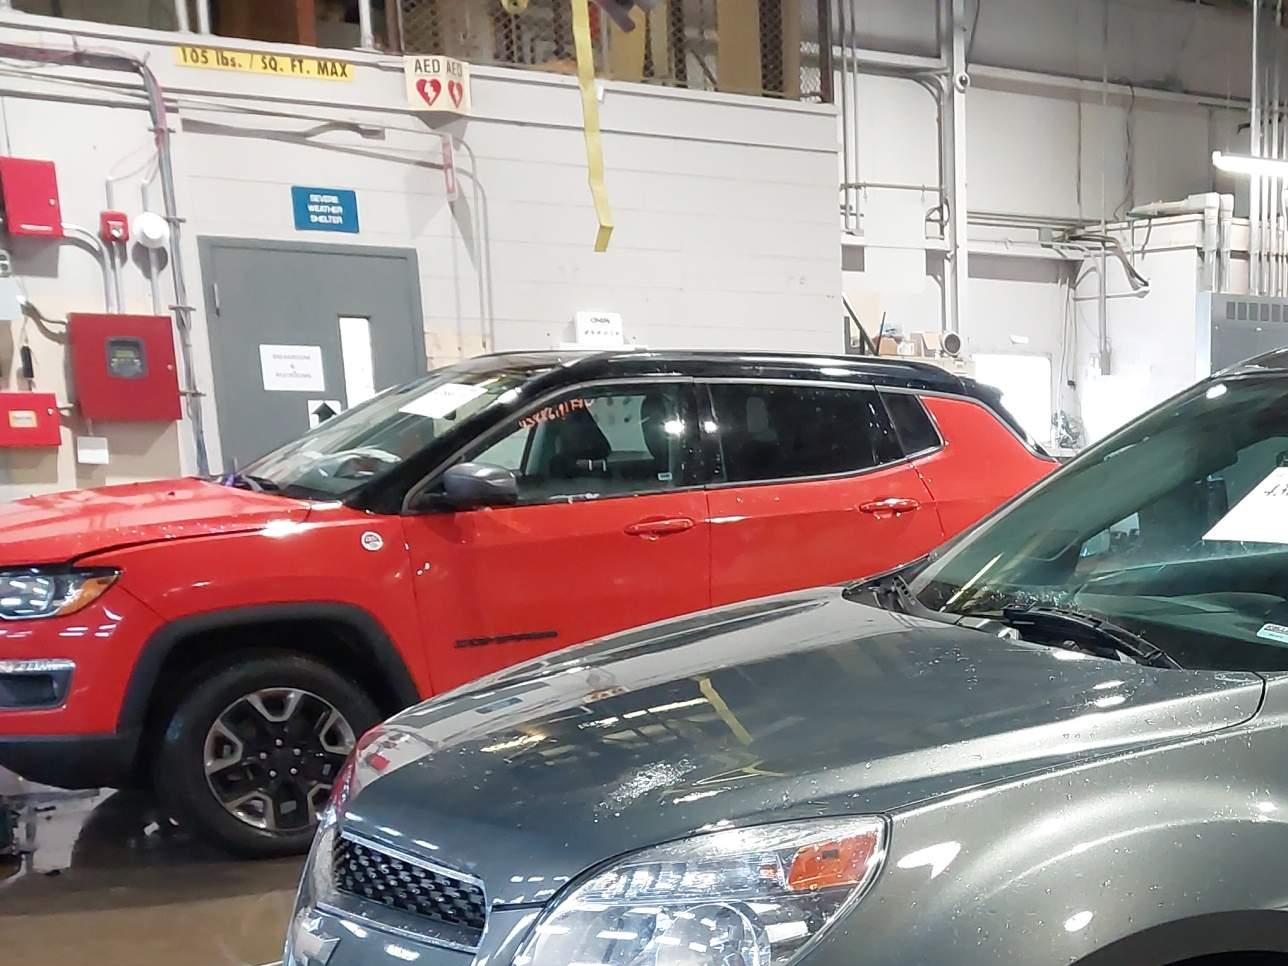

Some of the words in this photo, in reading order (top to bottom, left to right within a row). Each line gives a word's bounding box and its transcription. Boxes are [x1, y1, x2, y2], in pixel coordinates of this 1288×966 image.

[181, 47, 209, 64] 105
[216, 50, 242, 68] lbs.
[261, 56, 284, 72] SQ.
[291, 59, 311, 74] FT.
[317, 62, 348, 78] MAX
[415, 59, 440, 73] AED
[447, 61, 462, 77] AED
[309, 194, 339, 204] SEVERE
[308, 204, 343, 214] WEATHER
[310, 214, 343, 225] SHELTER
